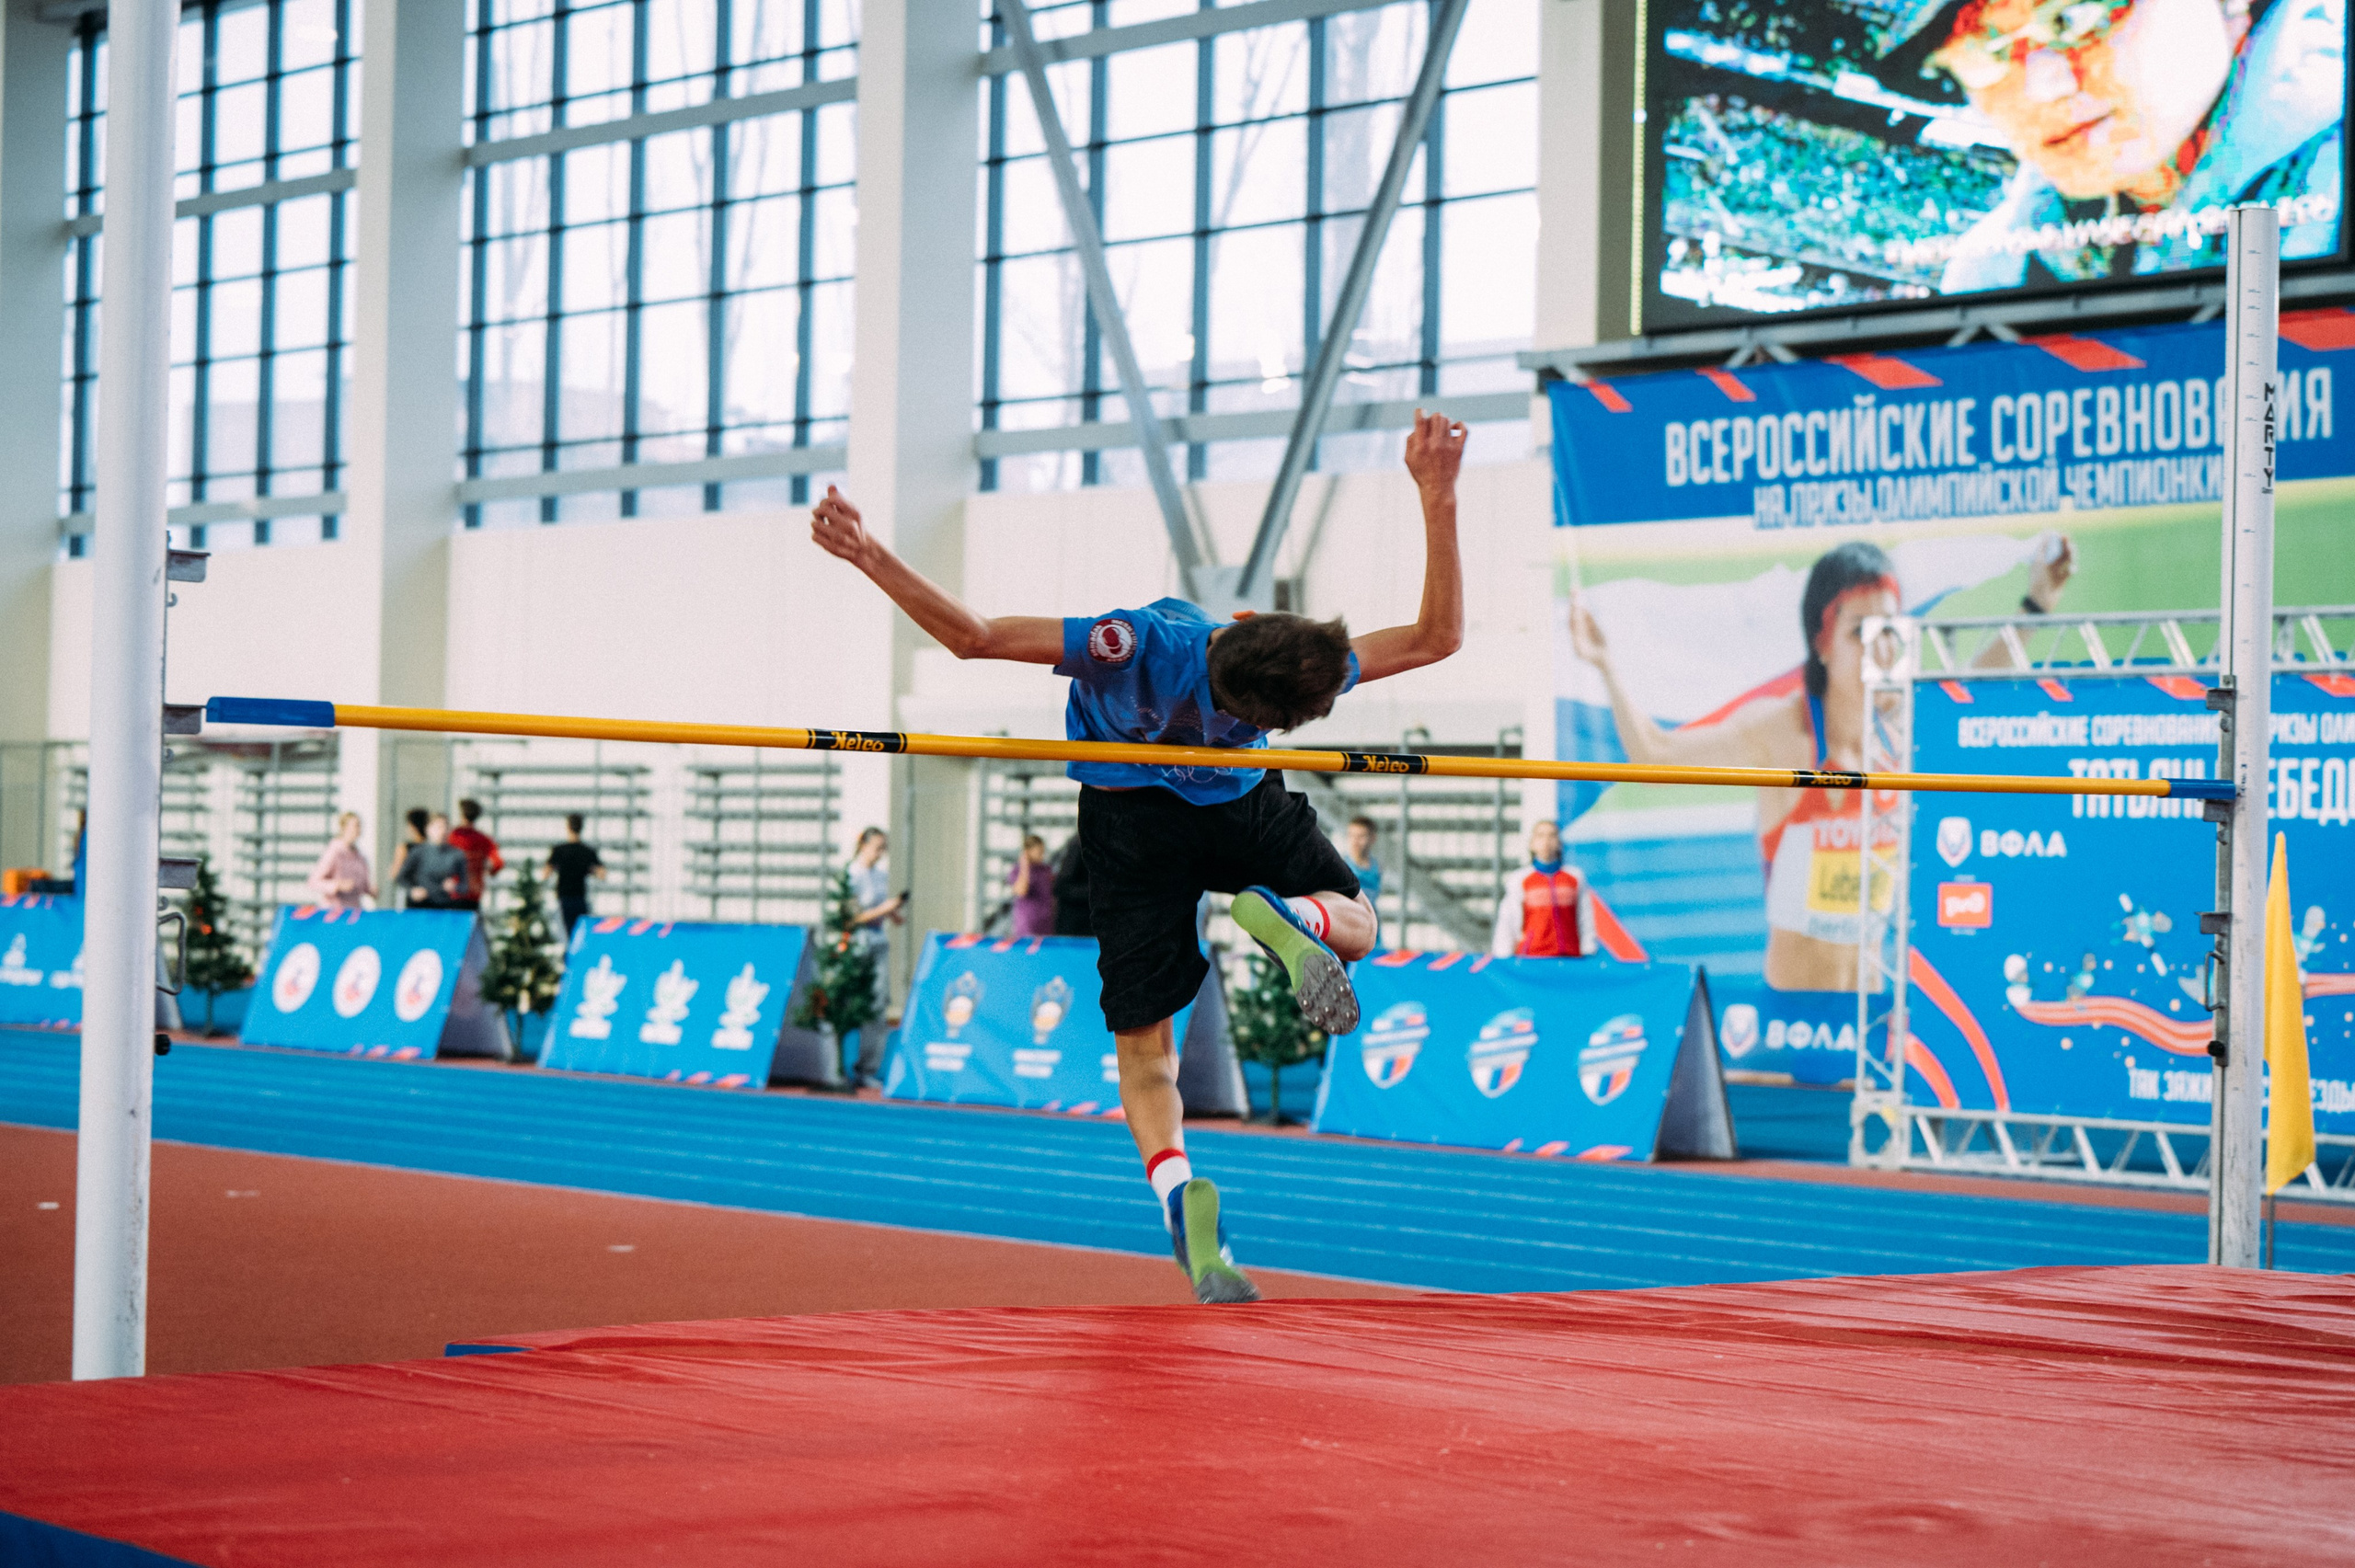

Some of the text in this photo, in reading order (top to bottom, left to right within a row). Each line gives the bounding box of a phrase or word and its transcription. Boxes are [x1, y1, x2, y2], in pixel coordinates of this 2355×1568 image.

[1665, 366, 2333, 486] ВСЕРОССИЙСКИЕ СОРЕВНОВИЯ
[2263, 382, 2276, 487] MARTY
[1753, 484, 1786, 530] НА
[1789, 477, 1874, 527] ПРИЗЫ
[1876, 453, 2061, 522] ОЛИМПИЙСКОЙ
[830, 730, 885, 752] Nelco
[1361, 754, 1410, 773] Nelco
